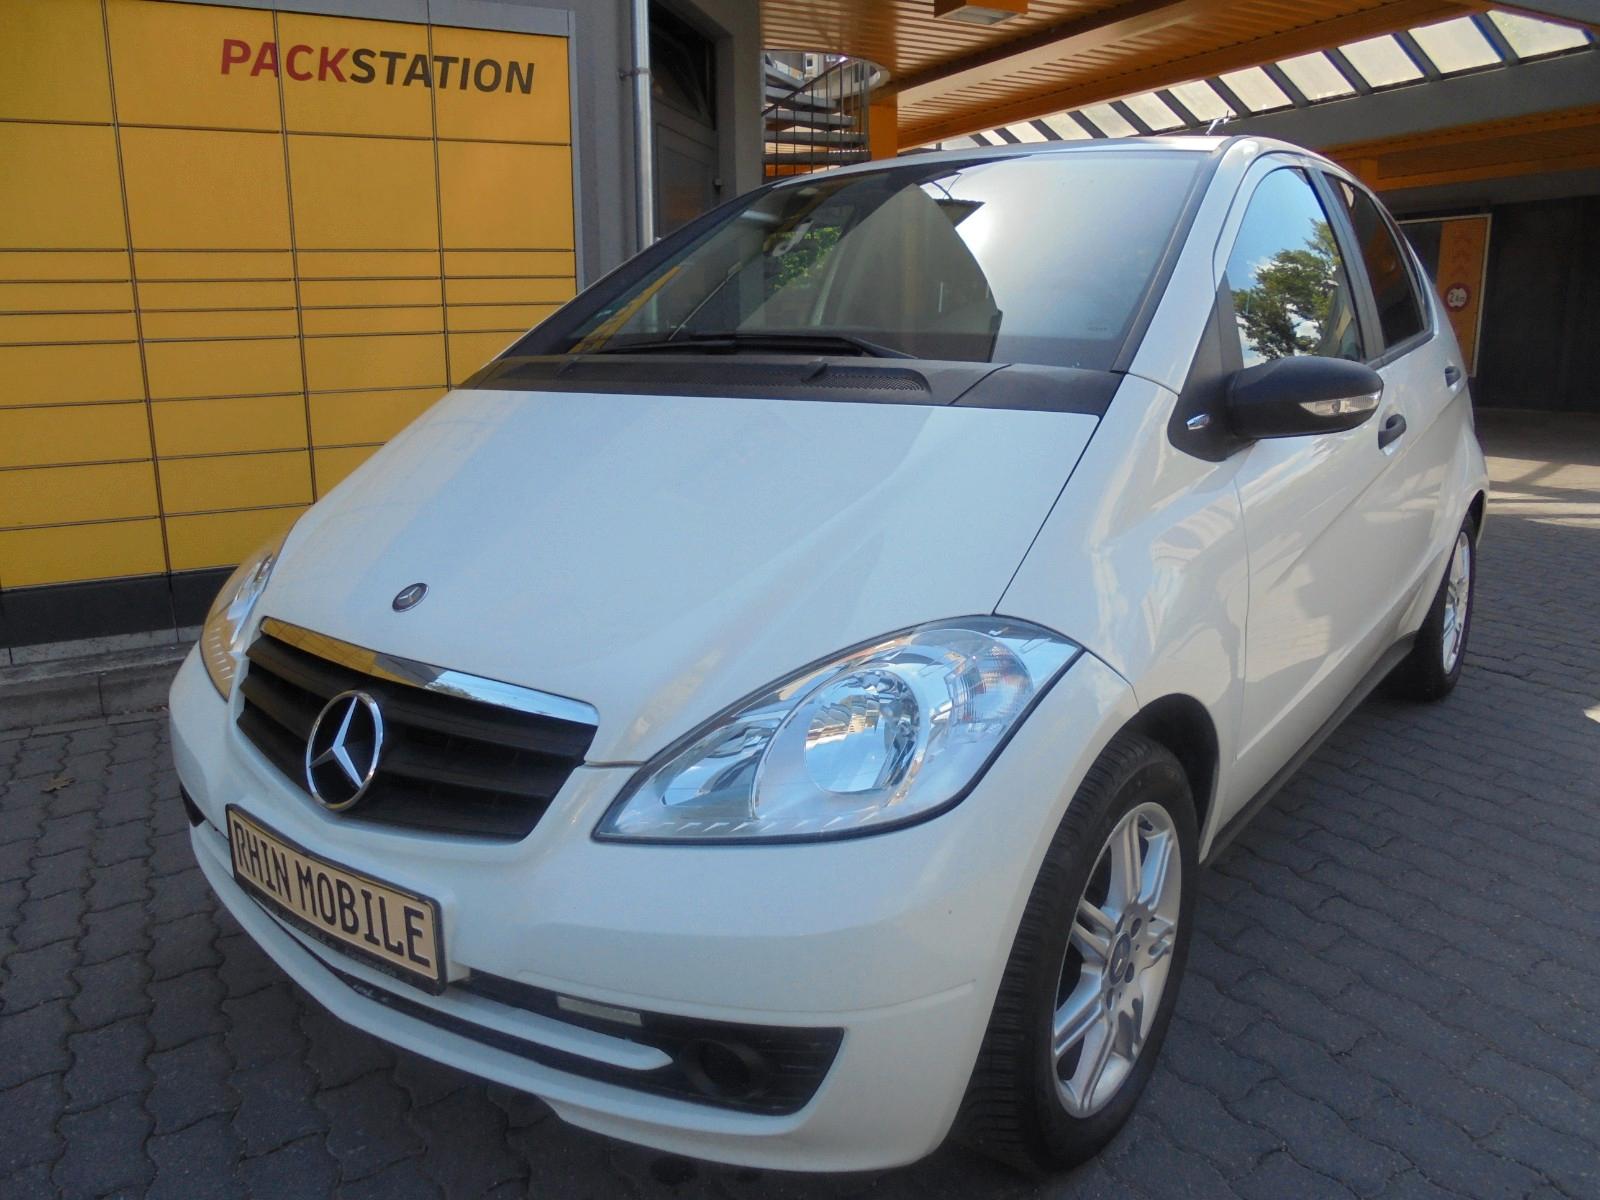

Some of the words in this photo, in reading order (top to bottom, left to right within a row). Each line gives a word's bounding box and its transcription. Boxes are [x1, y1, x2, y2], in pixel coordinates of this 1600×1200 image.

[221, 38, 535, 95] PACKSTATION
[233, 820, 293, 902] RHIN
[294, 859, 431, 968] MOBILE
